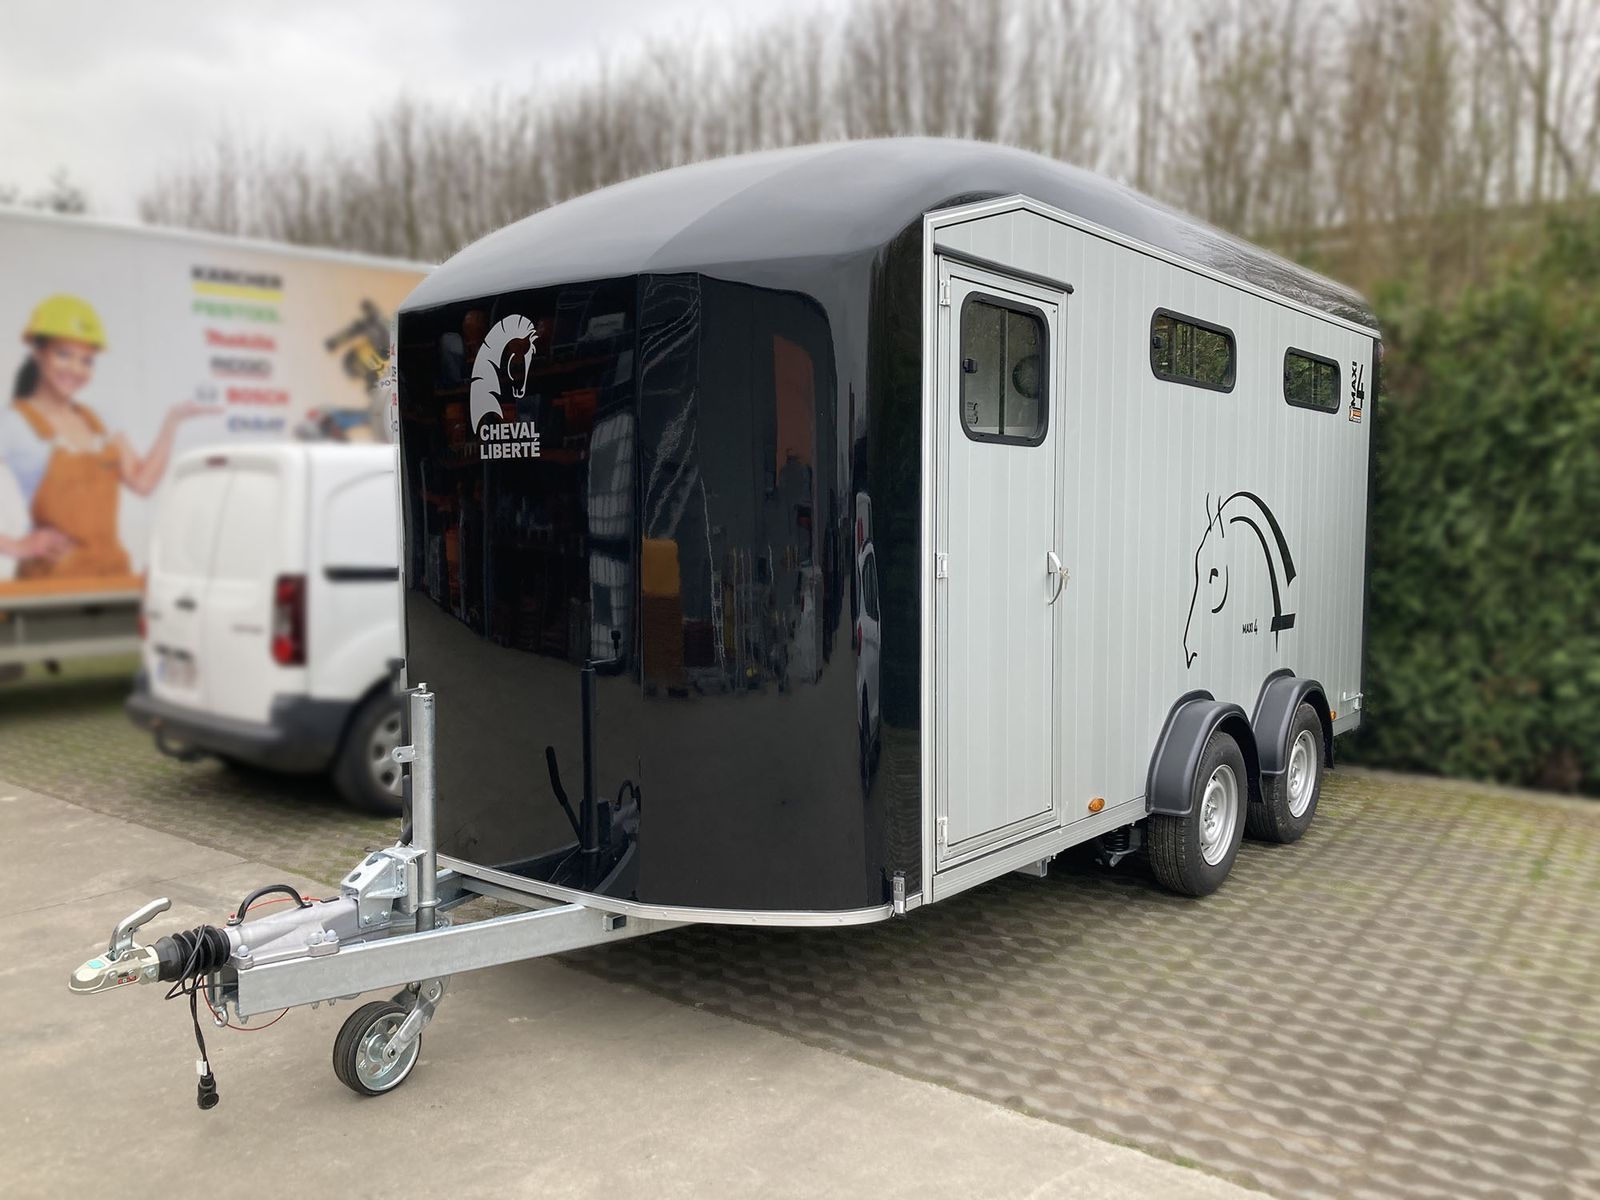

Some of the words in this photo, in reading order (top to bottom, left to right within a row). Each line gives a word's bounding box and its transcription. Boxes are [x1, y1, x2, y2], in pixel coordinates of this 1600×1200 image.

[480, 422, 540, 441] CHEVAL
[480, 438, 541, 460] LIBERTÉ
[1242, 622, 1253, 634] MAXI
